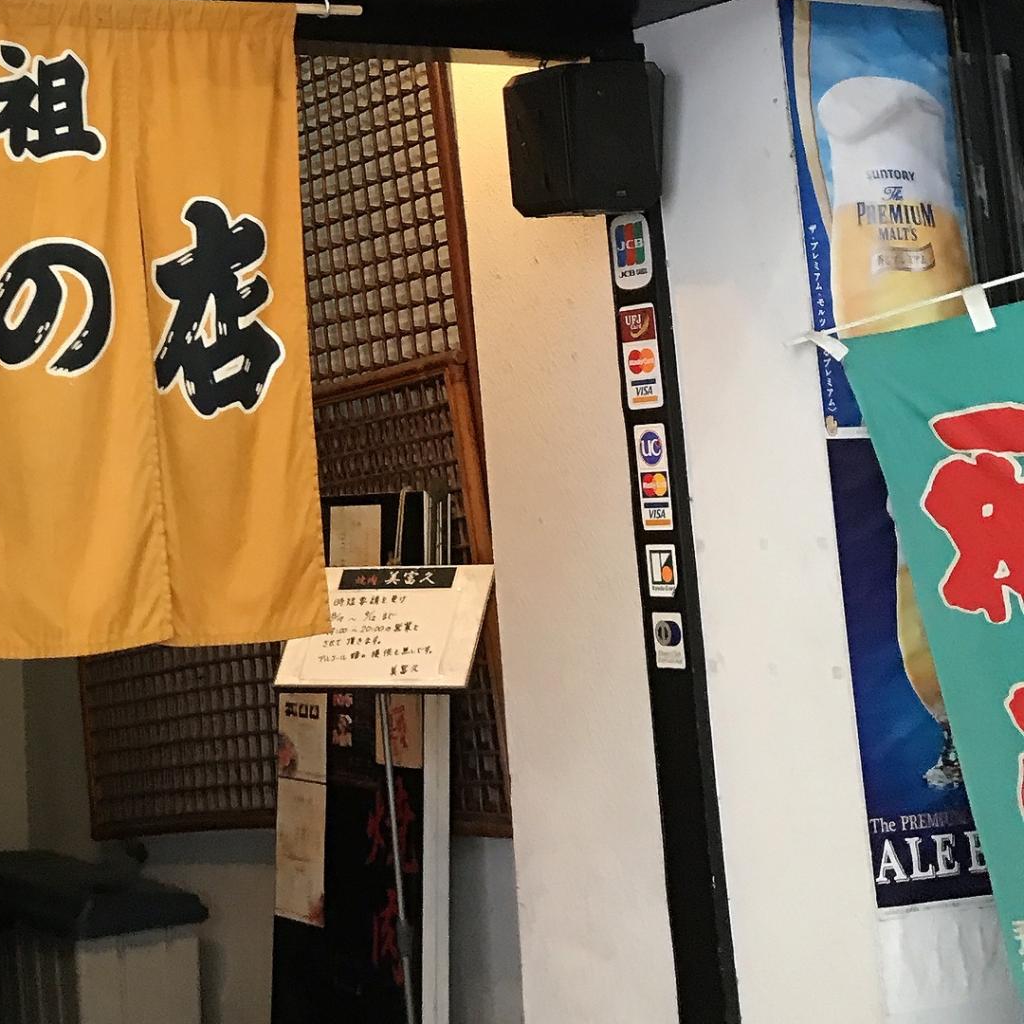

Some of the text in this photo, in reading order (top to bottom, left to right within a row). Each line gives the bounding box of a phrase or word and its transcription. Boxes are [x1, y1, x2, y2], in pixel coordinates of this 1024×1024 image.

[857, 201, 936, 228] PREMIUM
[616, 238, 643, 252] JCB
[624, 314, 642, 326] UFJ
[636, 385, 654, 397] VISA
[648, 508, 667, 519] VISA
[384, 570, 436, 586] 美富久
[869, 817, 897, 834] The
[876, 832, 961, 885] ALE
